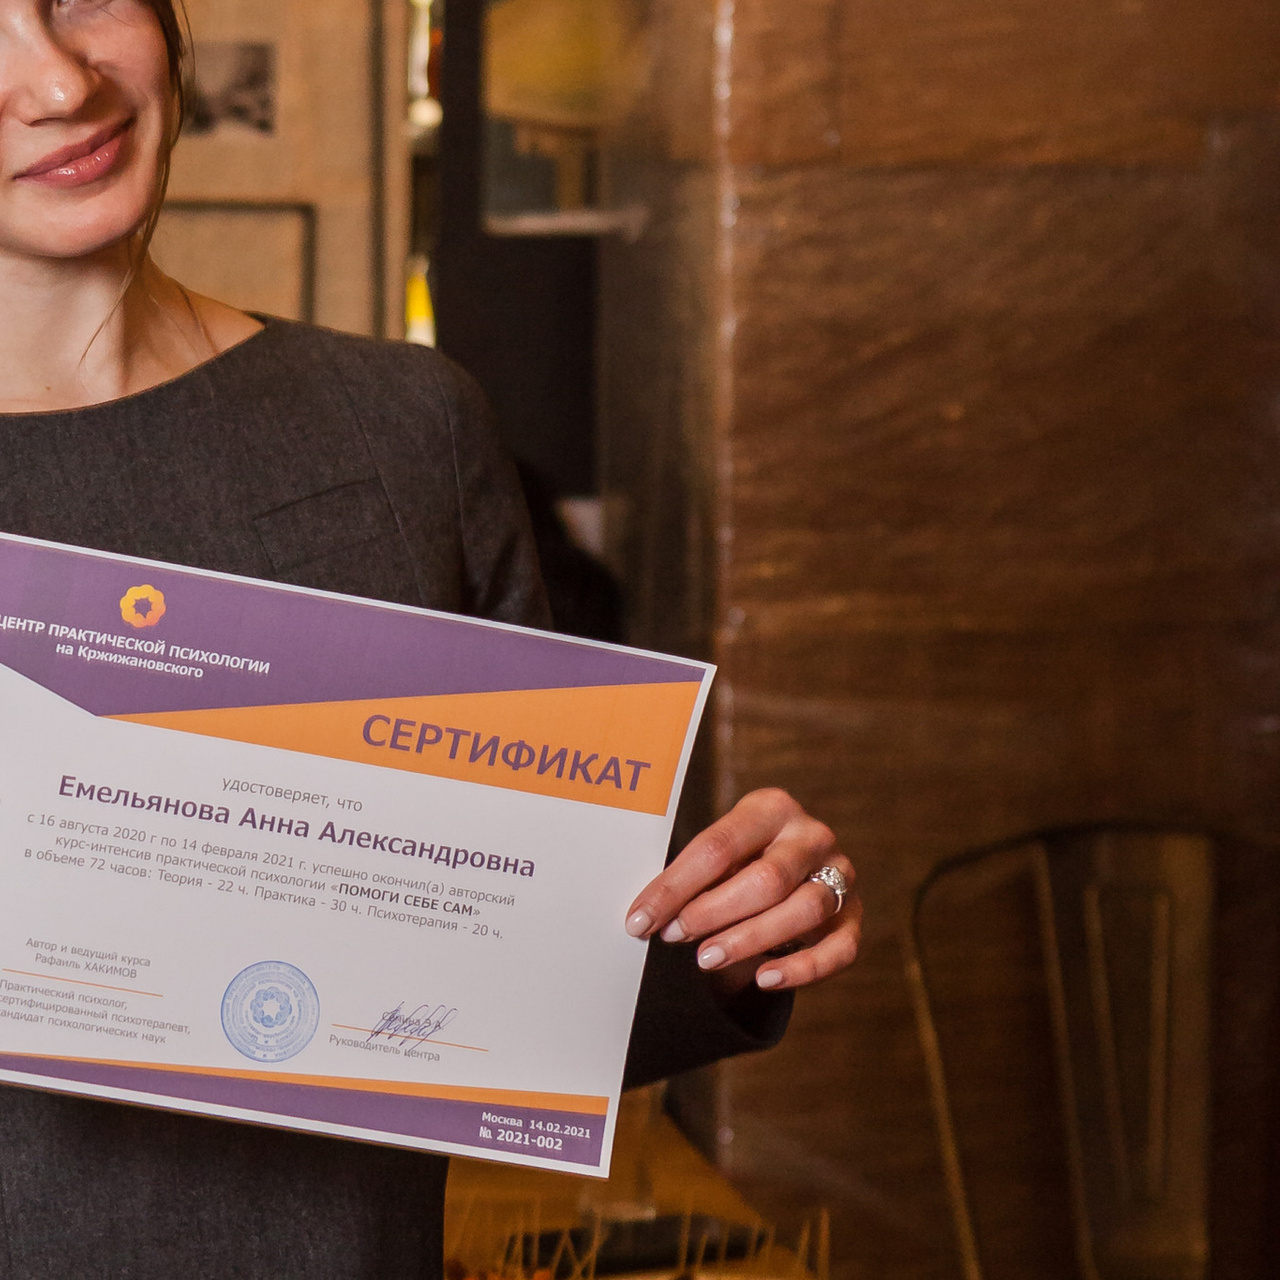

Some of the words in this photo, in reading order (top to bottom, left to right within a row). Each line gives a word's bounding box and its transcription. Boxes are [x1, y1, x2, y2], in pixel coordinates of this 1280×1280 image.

[48, 623, 166, 656] ПРАКТИЧЕСКОЙ
[168, 645, 271, 674] ПСИХОЛОГИИ
[55, 643, 74, 655] на
[77, 645, 204, 678] Кржижановского
[362, 714, 651, 792] СЕРТИФИКАТ
[222, 777, 330, 809] удостоверяет,
[337, 797, 363, 812] что
[58, 774, 230, 825] Емельянова
[238, 807, 310, 838] Анна
[317, 820, 535, 878] Александровна
[27, 813, 35, 823] с
[39, 813, 55, 827] 16
[58, 819, 109, 836] августа
[112, 826, 147, 843] 2020
[149, 834, 158, 844] г
[160, 836, 177, 848] по
[182, 838, 197, 851] 14
[201, 841, 259, 862] февраля
[262, 851, 294, 868] 2021
[298, 860, 307, 871] г.
[312, 863, 369, 881] успешно
[371, 873, 445, 897] окончил(а)
[448, 886, 515, 907] авторский
[55, 836, 152, 861] курс-интенсив
[155, 853, 247, 878] практической
[250, 869, 326, 891] психологии
[330, 882, 400, 904] «ПОМОГИ
[403, 894, 440, 911] СЕБЕ
[442, 900, 481, 917] САМ»
[24, 848, 32, 858] в
[36, 849, 85, 867] объеме
[90, 857, 106, 871] 72
[110, 863, 152, 879] часов:
[158, 868, 203, 888] Теория
[217, 879, 234, 893] 22
[238, 885, 249, 896] ч.
[254, 885, 316, 907] Практика
[330, 898, 347, 912] 30
[351, 904, 362, 915] ч.
[367, 905, 458, 931] Психотерапия
[471, 923, 489, 937] 20
[492, 929, 503, 939] ч.
[25, 937, 58, 953] Автор
[60, 945, 68, 953] и
[70, 946, 118, 961] ведущий
[120, 955, 151, 967] курса
[34, 952, 81, 969] Рафаиль
[84, 961, 137, 979] ХАКИМОВ
[0, 978, 75, 1000] Практический
[77, 994, 128, 1011] психолог,
[47, 1017, 139, 1039] психологических
[141, 1033, 166, 1045] наук
[111, 1013, 191, 1035] психотерапевт,
[328, 1033, 401, 1055] Руководитель
[403, 1048, 441, 1062] центра
[481, 1111, 523, 1128] Москва
[529, 1119, 591, 1139] 14.02.2021
[496, 1128, 563, 1151] 2021-002
